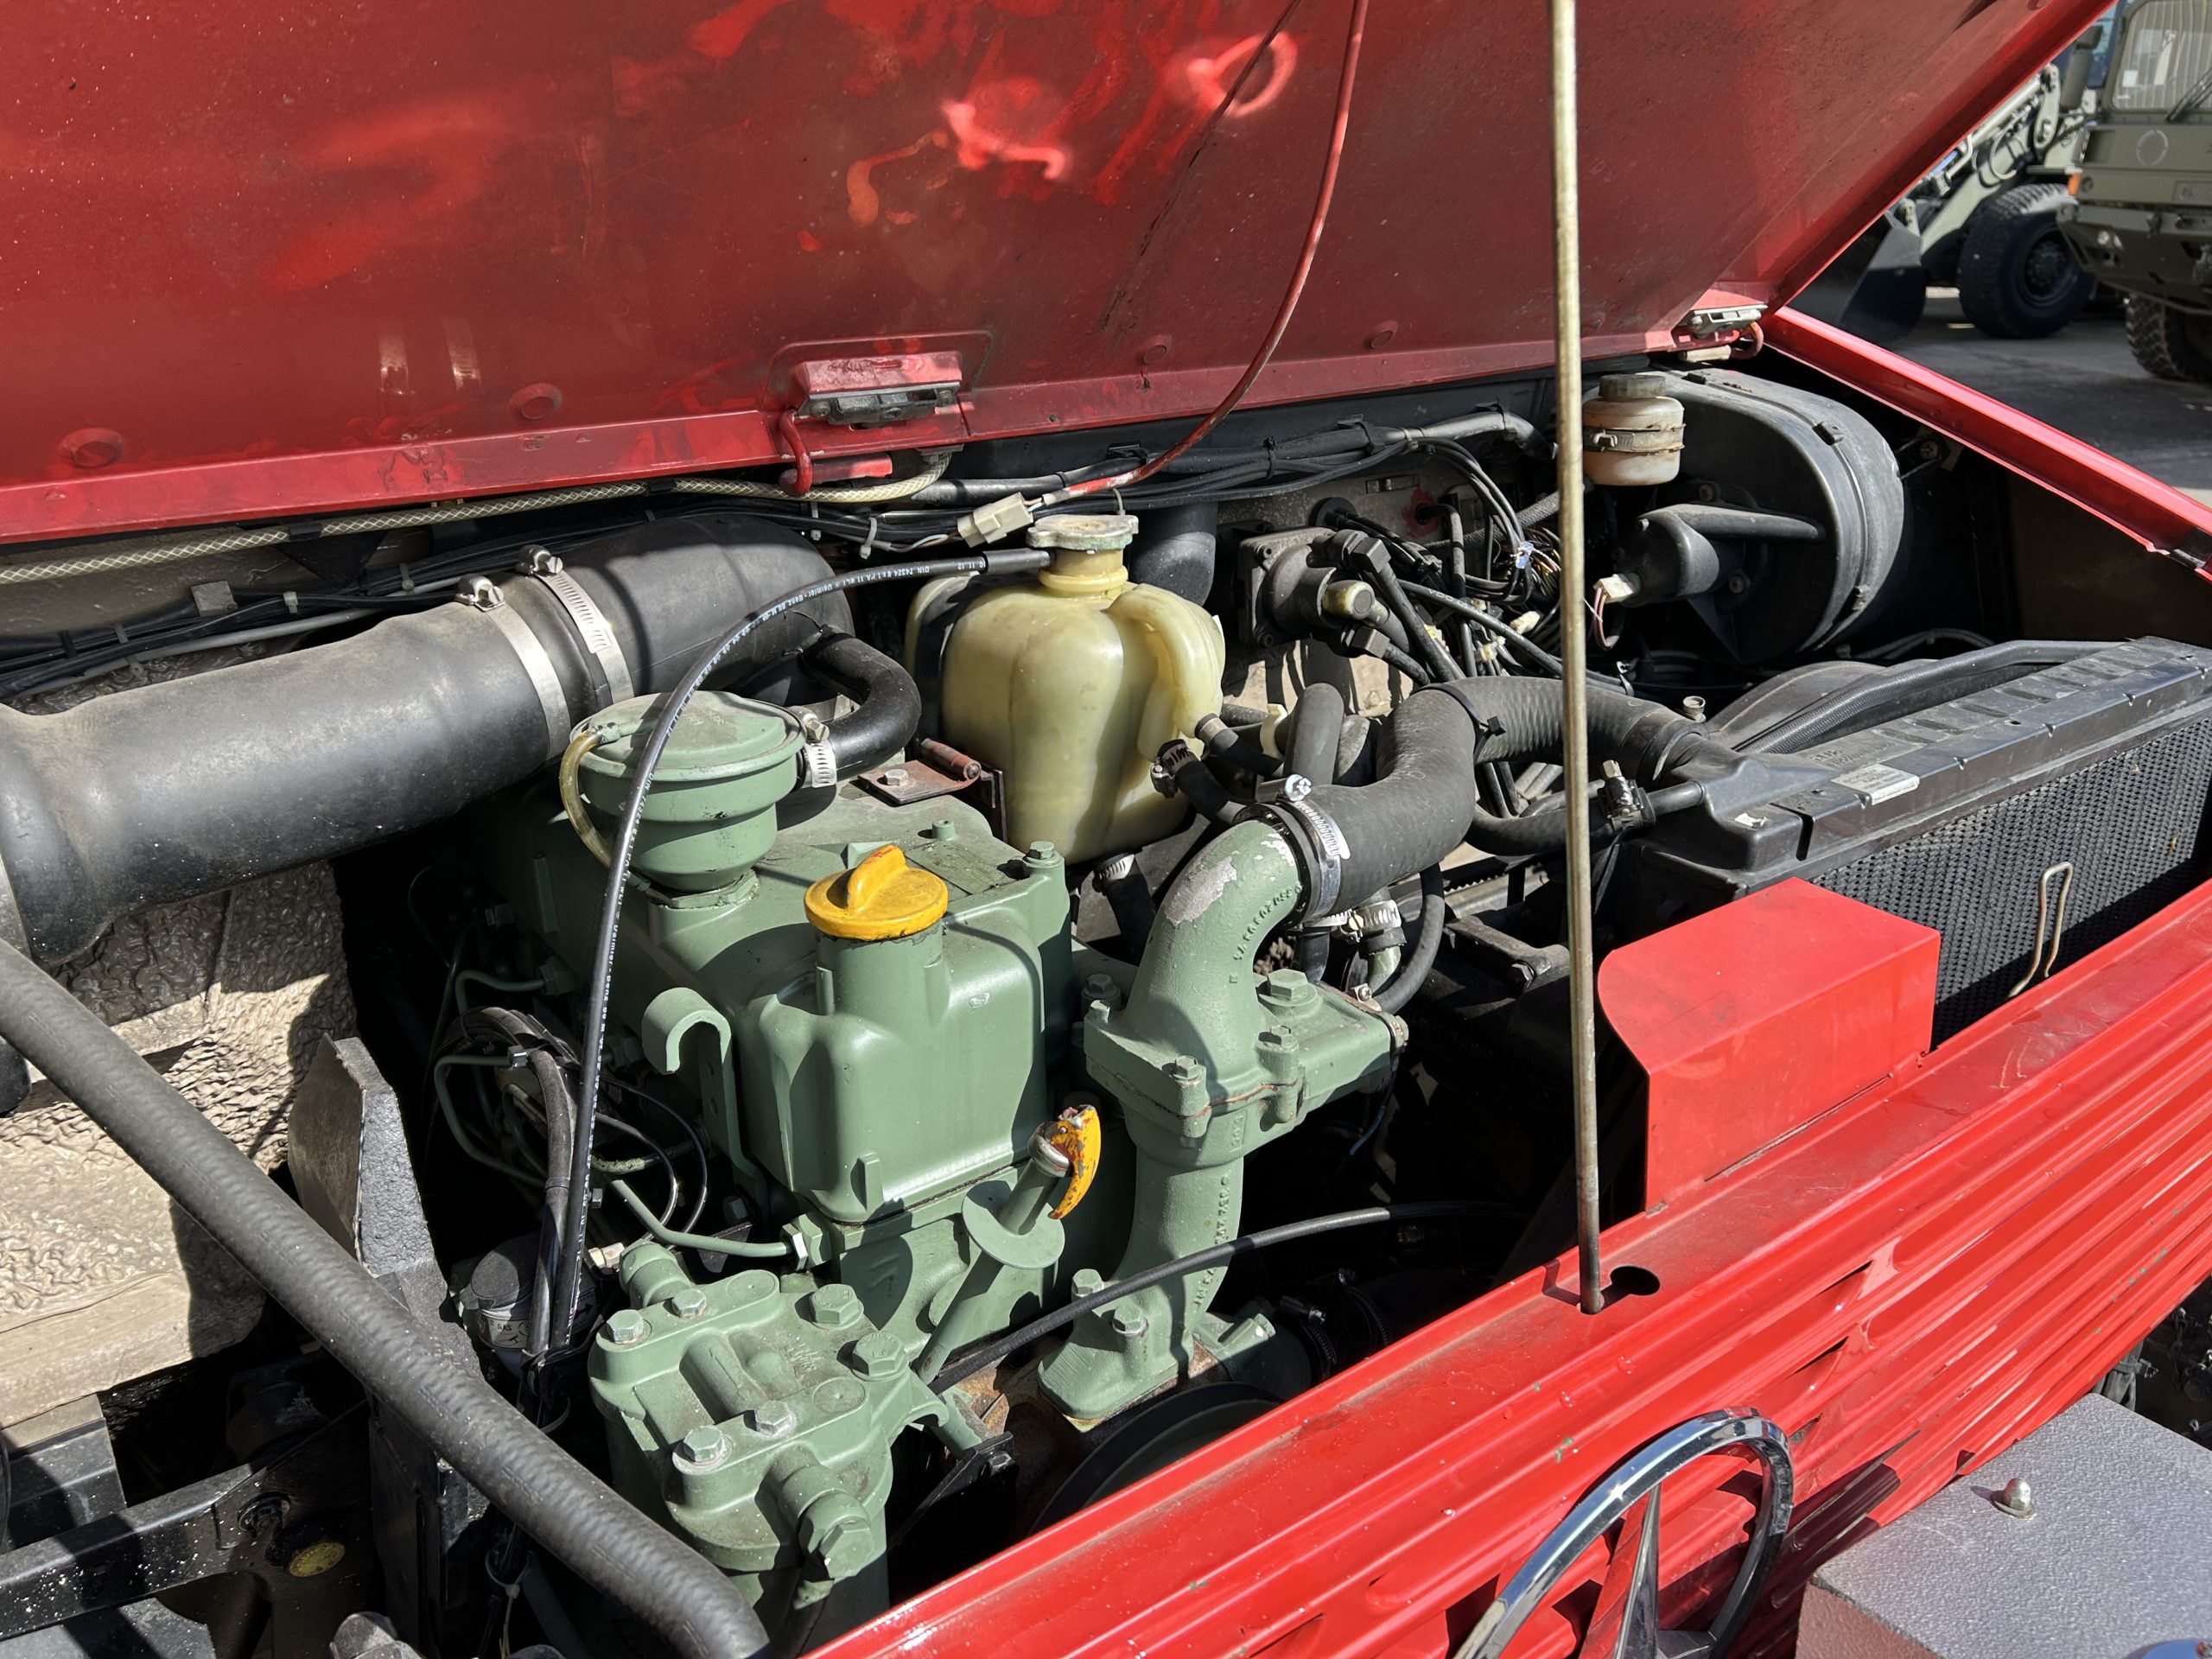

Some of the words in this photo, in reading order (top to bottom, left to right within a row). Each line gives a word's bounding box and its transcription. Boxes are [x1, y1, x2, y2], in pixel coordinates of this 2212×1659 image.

[893, 567, 913, 576] 74324
[916, 565, 929, 574] DIN
[645, 772, 654, 791] DIN
